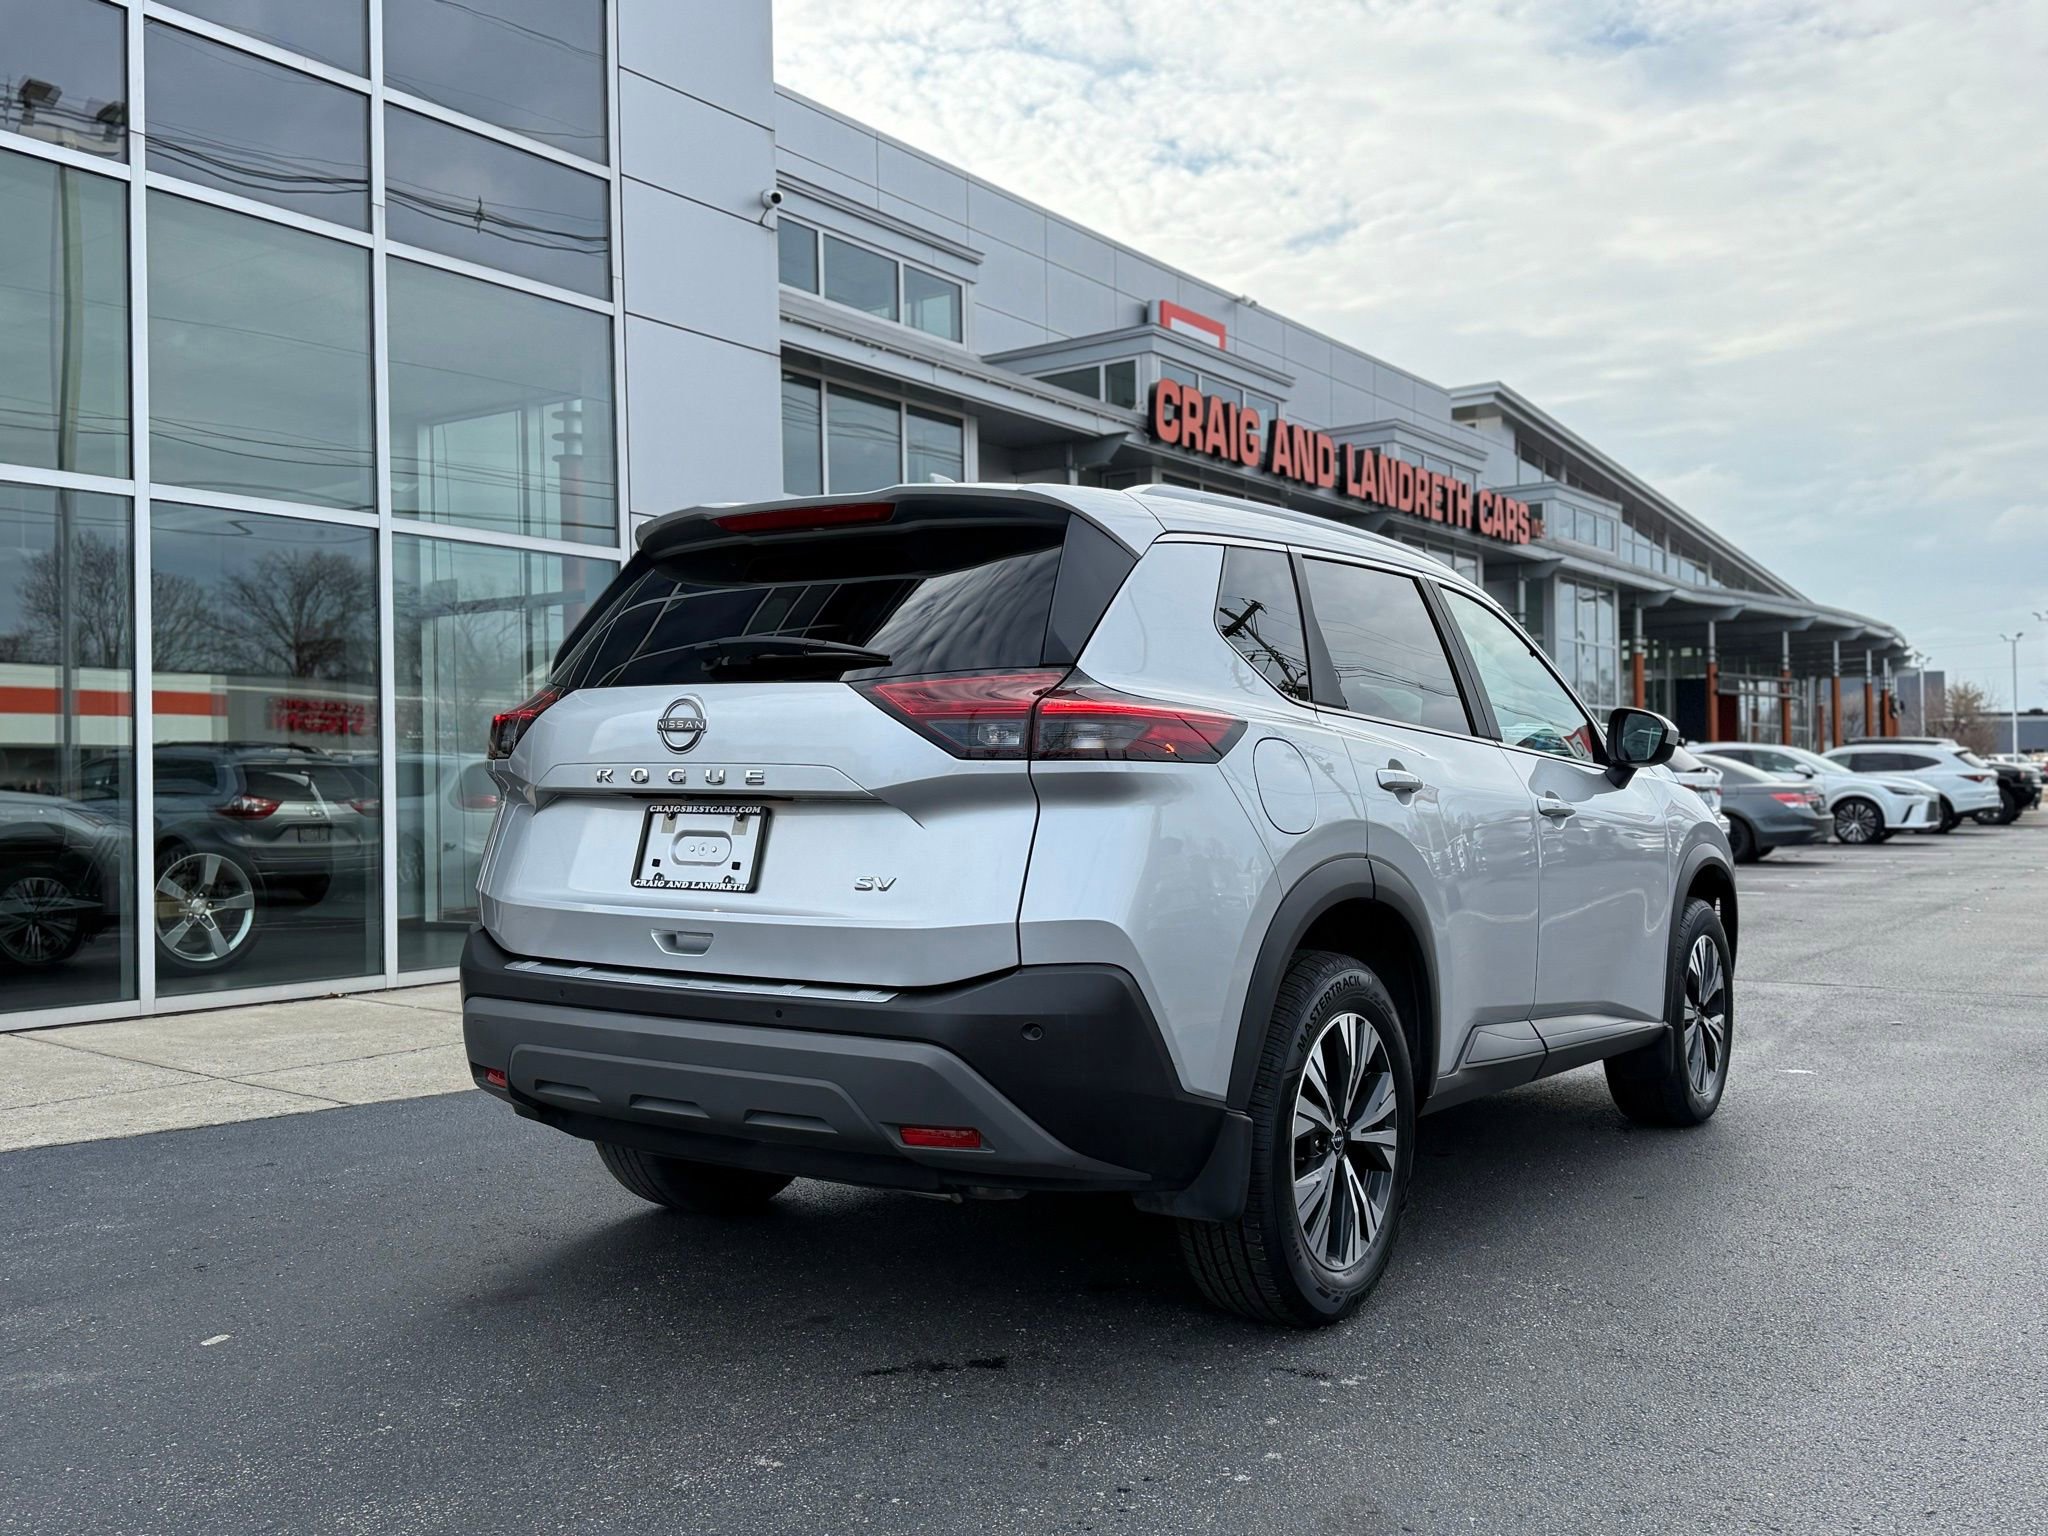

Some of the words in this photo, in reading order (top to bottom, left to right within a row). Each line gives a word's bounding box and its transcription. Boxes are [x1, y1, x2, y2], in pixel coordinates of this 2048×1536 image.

[1154, 377, 1261, 467] CRAIG
[1271, 419, 1336, 489] AND
[1345, 443, 1472, 530] LANDRETH
[1478, 488, 1530, 545] CARS
[658, 719, 705, 729] NISSAN
[596, 767, 766, 786] ROGUE
[649, 804, 762, 815] CRAIGSBESTCARS.COM
[633, 879, 665, 888] CRAIG
[665, 881, 689, 889] AND
[690, 881, 748, 892] LANDRETH
[853, 875, 897, 892] SV
[1297, 975, 1361, 1054] MASTERTRACK
